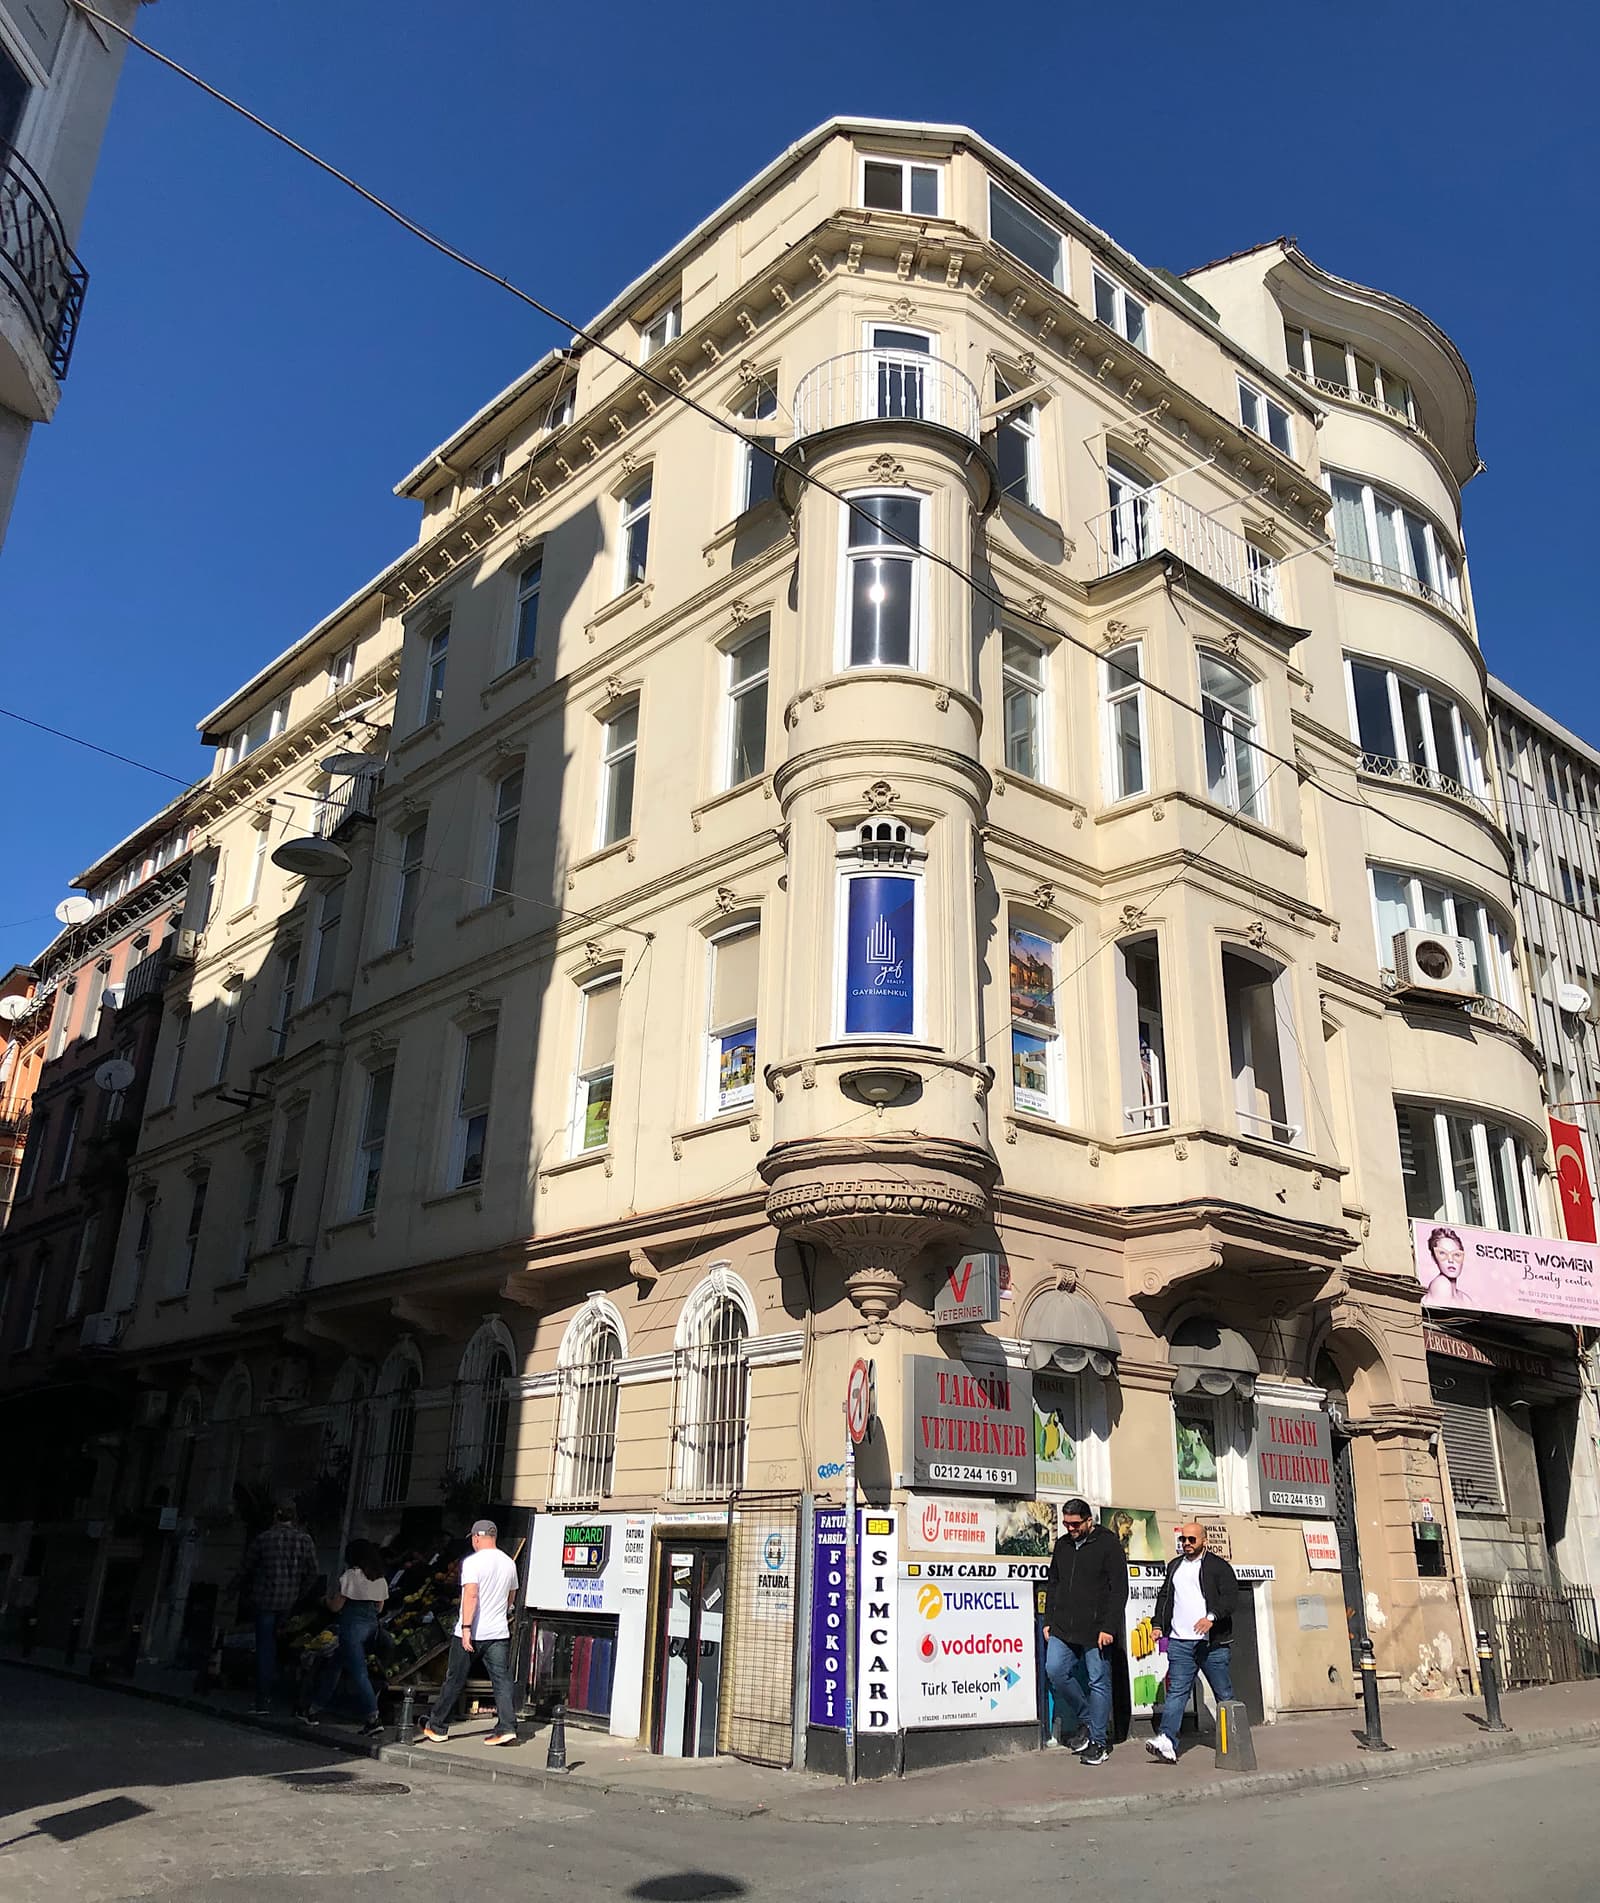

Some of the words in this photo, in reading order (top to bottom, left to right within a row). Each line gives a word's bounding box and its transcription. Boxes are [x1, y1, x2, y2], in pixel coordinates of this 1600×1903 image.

[852, 988, 908, 997] GAYRİMENKUL
[1475, 1243, 1530, 1265] SECRET
[1534, 1252, 1593, 1273] WOMEN
[1522, 1265, 1561, 1289] Beauty
[1565, 1275, 1593, 1288] center
[937, 1371, 1011, 1412] TAKSİM
[921, 1414, 1027, 1457] VETERİNER
[1268, 1413, 1318, 1448] TAKSİM
[934, 1465, 960, 1479] 0212
[963, 1467, 982, 1480] 244
[986, 1469, 998, 1481] 16
[1000, 1470, 1012, 1483] 91
[1261, 1450, 1330, 1485] VETERİNER
[1271, 1492, 1289, 1504] 0212
[1290, 1493, 1303, 1505] 244
[1304, 1494, 1314, 1506] 16
[1314, 1495, 1323, 1506] 91
[944, 1510, 979, 1525] TAKSİM
[565, 1527, 603, 1543] SIMCARD
[625, 1528, 645, 1539] FATURA
[625, 1540, 644, 1553] ÖDEME
[927, 1564, 954, 1577] SIM
[957, 1564, 997, 1577] CARD
[758, 1574, 790, 1589] FATURA
[943, 1592, 1019, 1610] TURKCELL
[825, 1551, 841, 1717] FOTOKOPİ
[869, 1551, 890, 1728] SIMCARD
[941, 1633, 1023, 1655] vodafone
[921, 1681, 948, 1696] Türk
[951, 1680, 1001, 1694] Telekom
